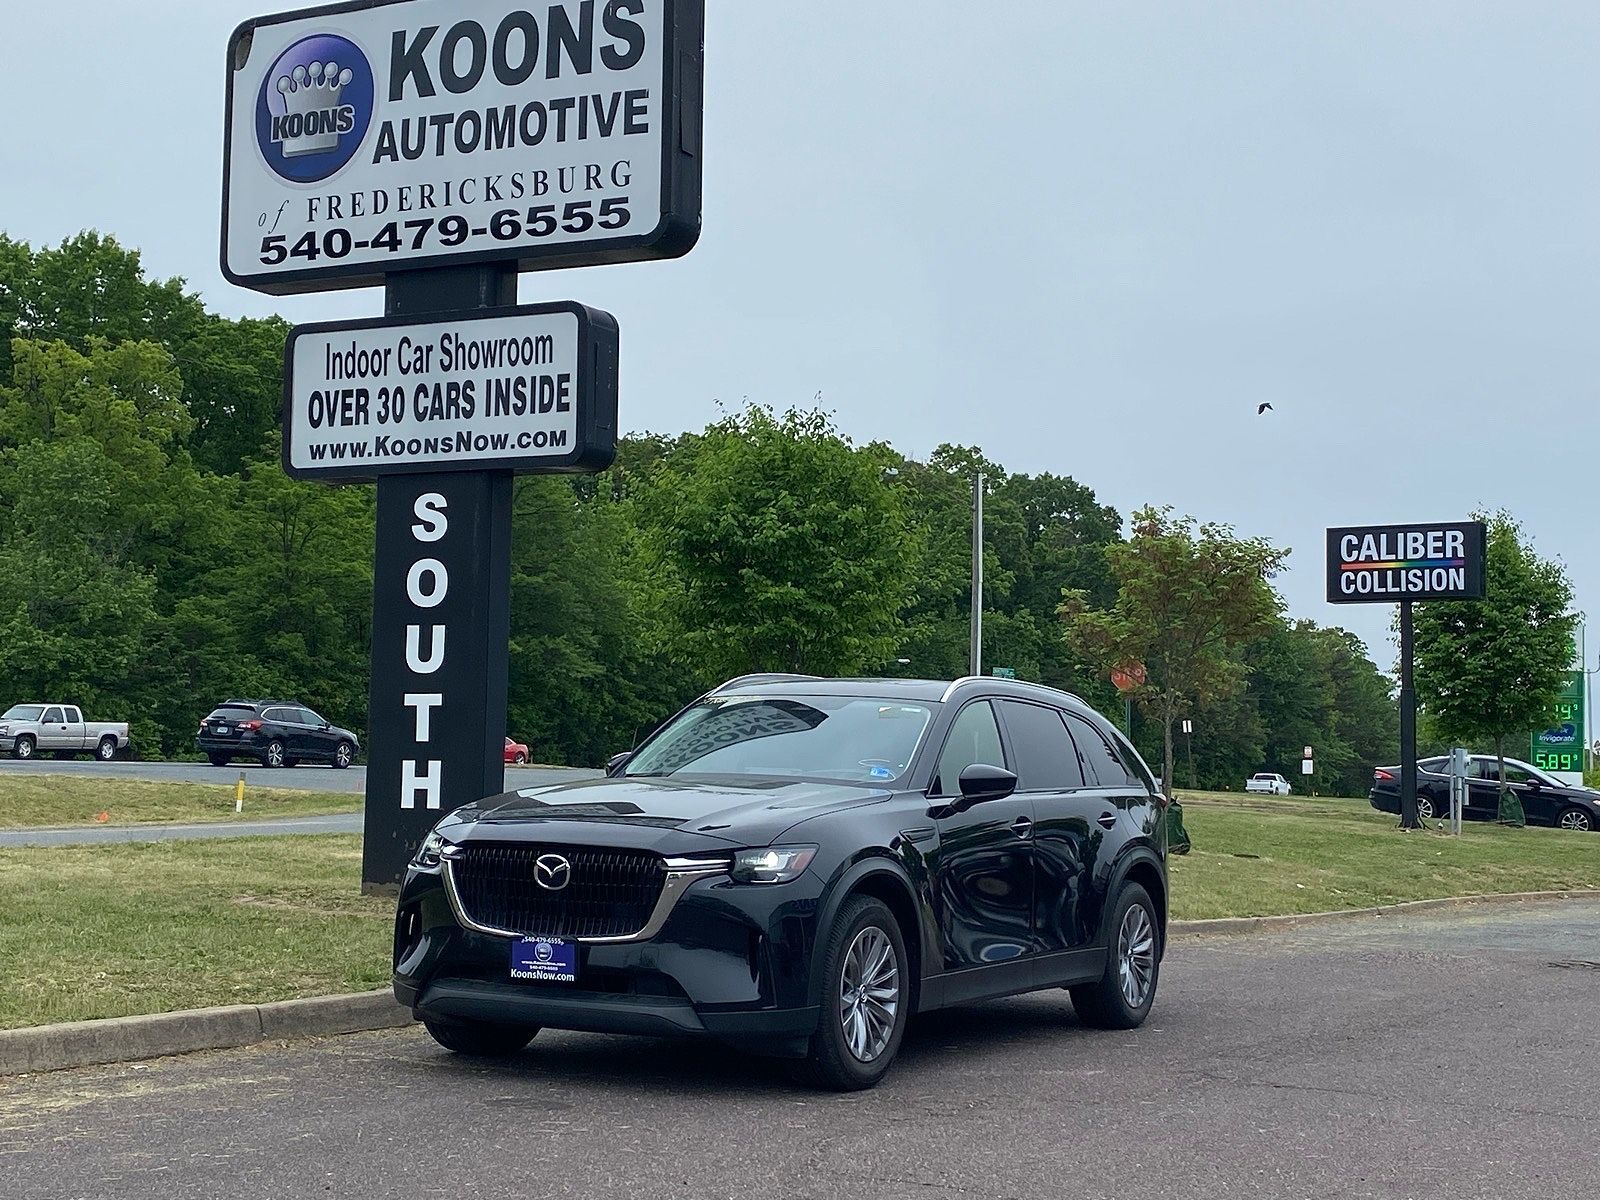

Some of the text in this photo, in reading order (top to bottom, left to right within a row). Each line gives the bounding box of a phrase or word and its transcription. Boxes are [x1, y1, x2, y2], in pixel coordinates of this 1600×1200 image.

[388, 0, 646, 102] KOONS
[271, 105, 354, 141] KOONS
[372, 88, 650, 165] AUTOMOTIVE
[258, 159, 632, 234] of FREDERICKSBURG
[259, 196, 631, 265] 540-479-6555
[326, 332, 553, 381] Indoor Car Showroom
[308, 373, 571, 429] OVER 30 CARS INSIDE
[1340, 530, 1465, 562] CALIBER
[1340, 567, 1465, 594] COLLISION
[401, 492, 448, 809] SOUTH
[510, 968, 575, 981] KoonsNow.com
